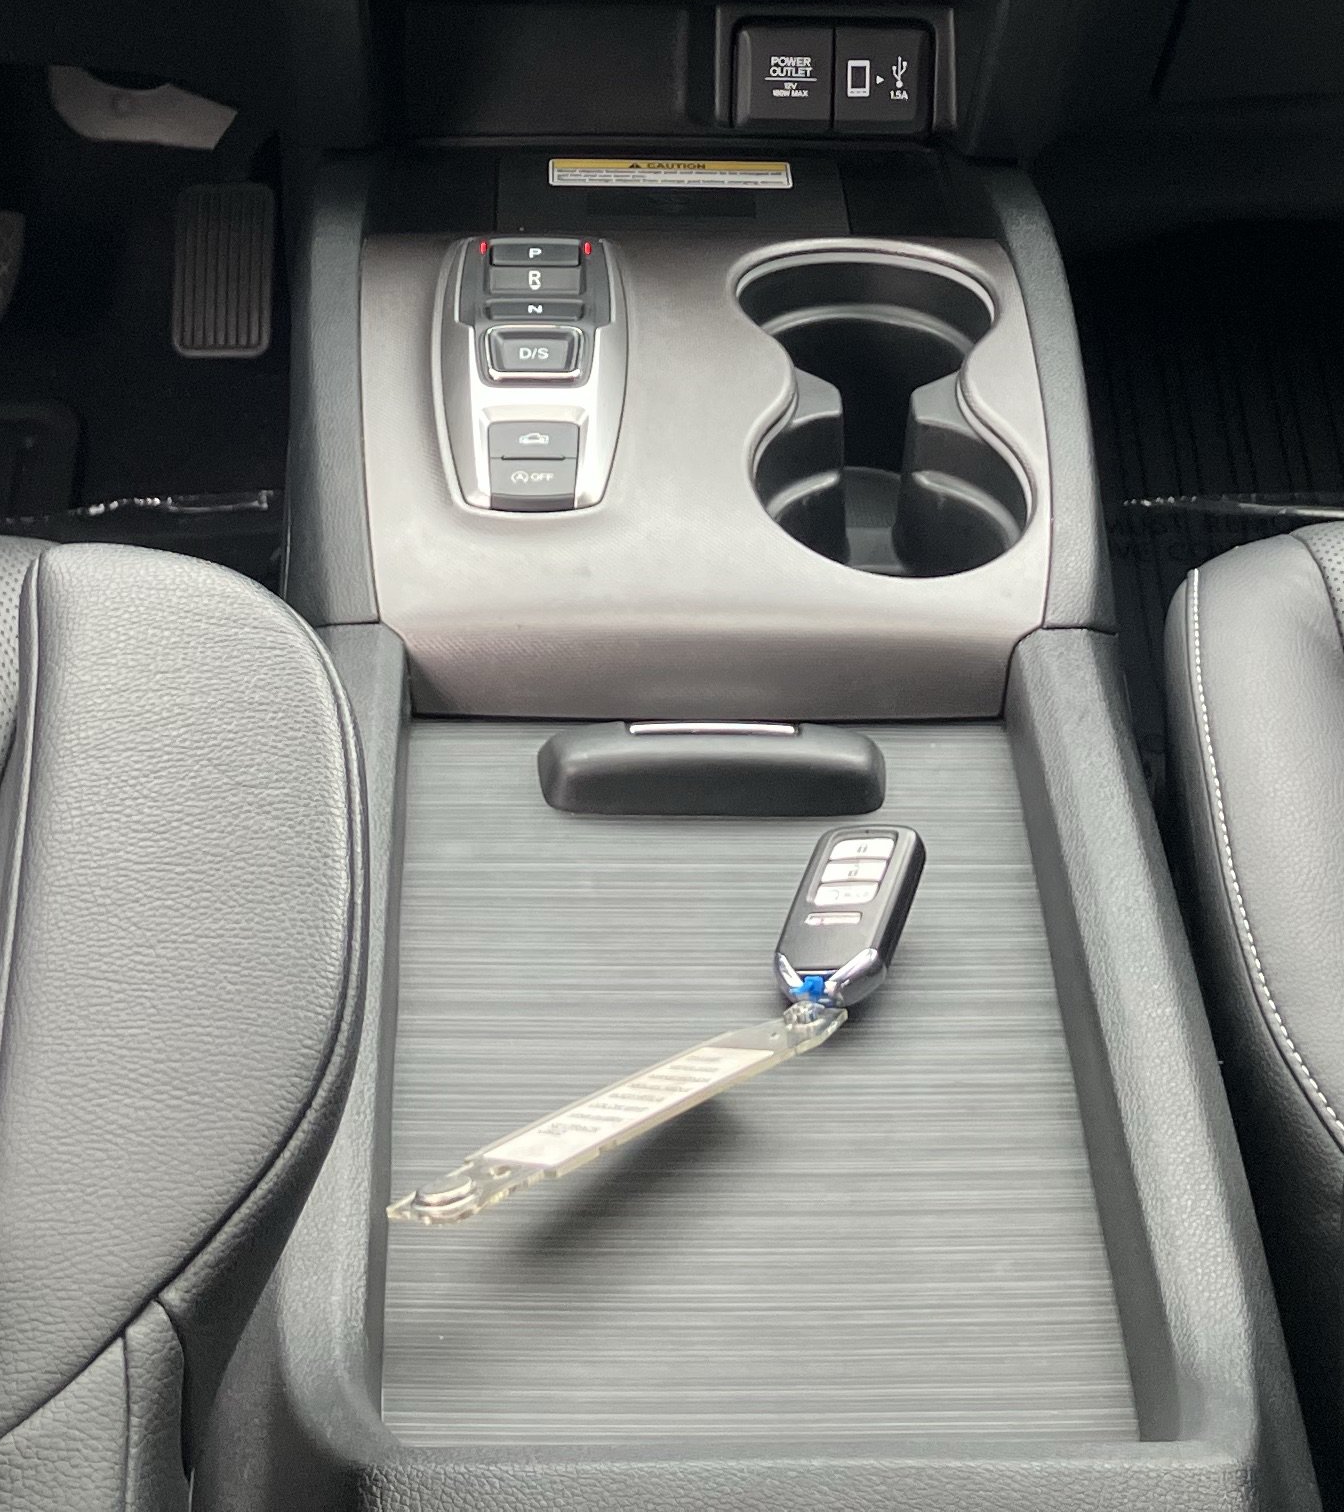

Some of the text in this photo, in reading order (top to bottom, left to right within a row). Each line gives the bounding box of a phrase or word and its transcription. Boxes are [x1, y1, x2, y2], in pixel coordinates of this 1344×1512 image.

[770, 56, 812, 67] POWER
[769, 66, 813, 77] OUTLET
[889, 90, 909, 101] 1.5A
[646, 162, 707, 170] CAUTION
[528, 247, 542, 259] P
[528, 270, 542, 287] R
[527, 304, 544, 314] N
[519, 347, 549, 359] D/S
[530, 473, 554, 481] OFF
